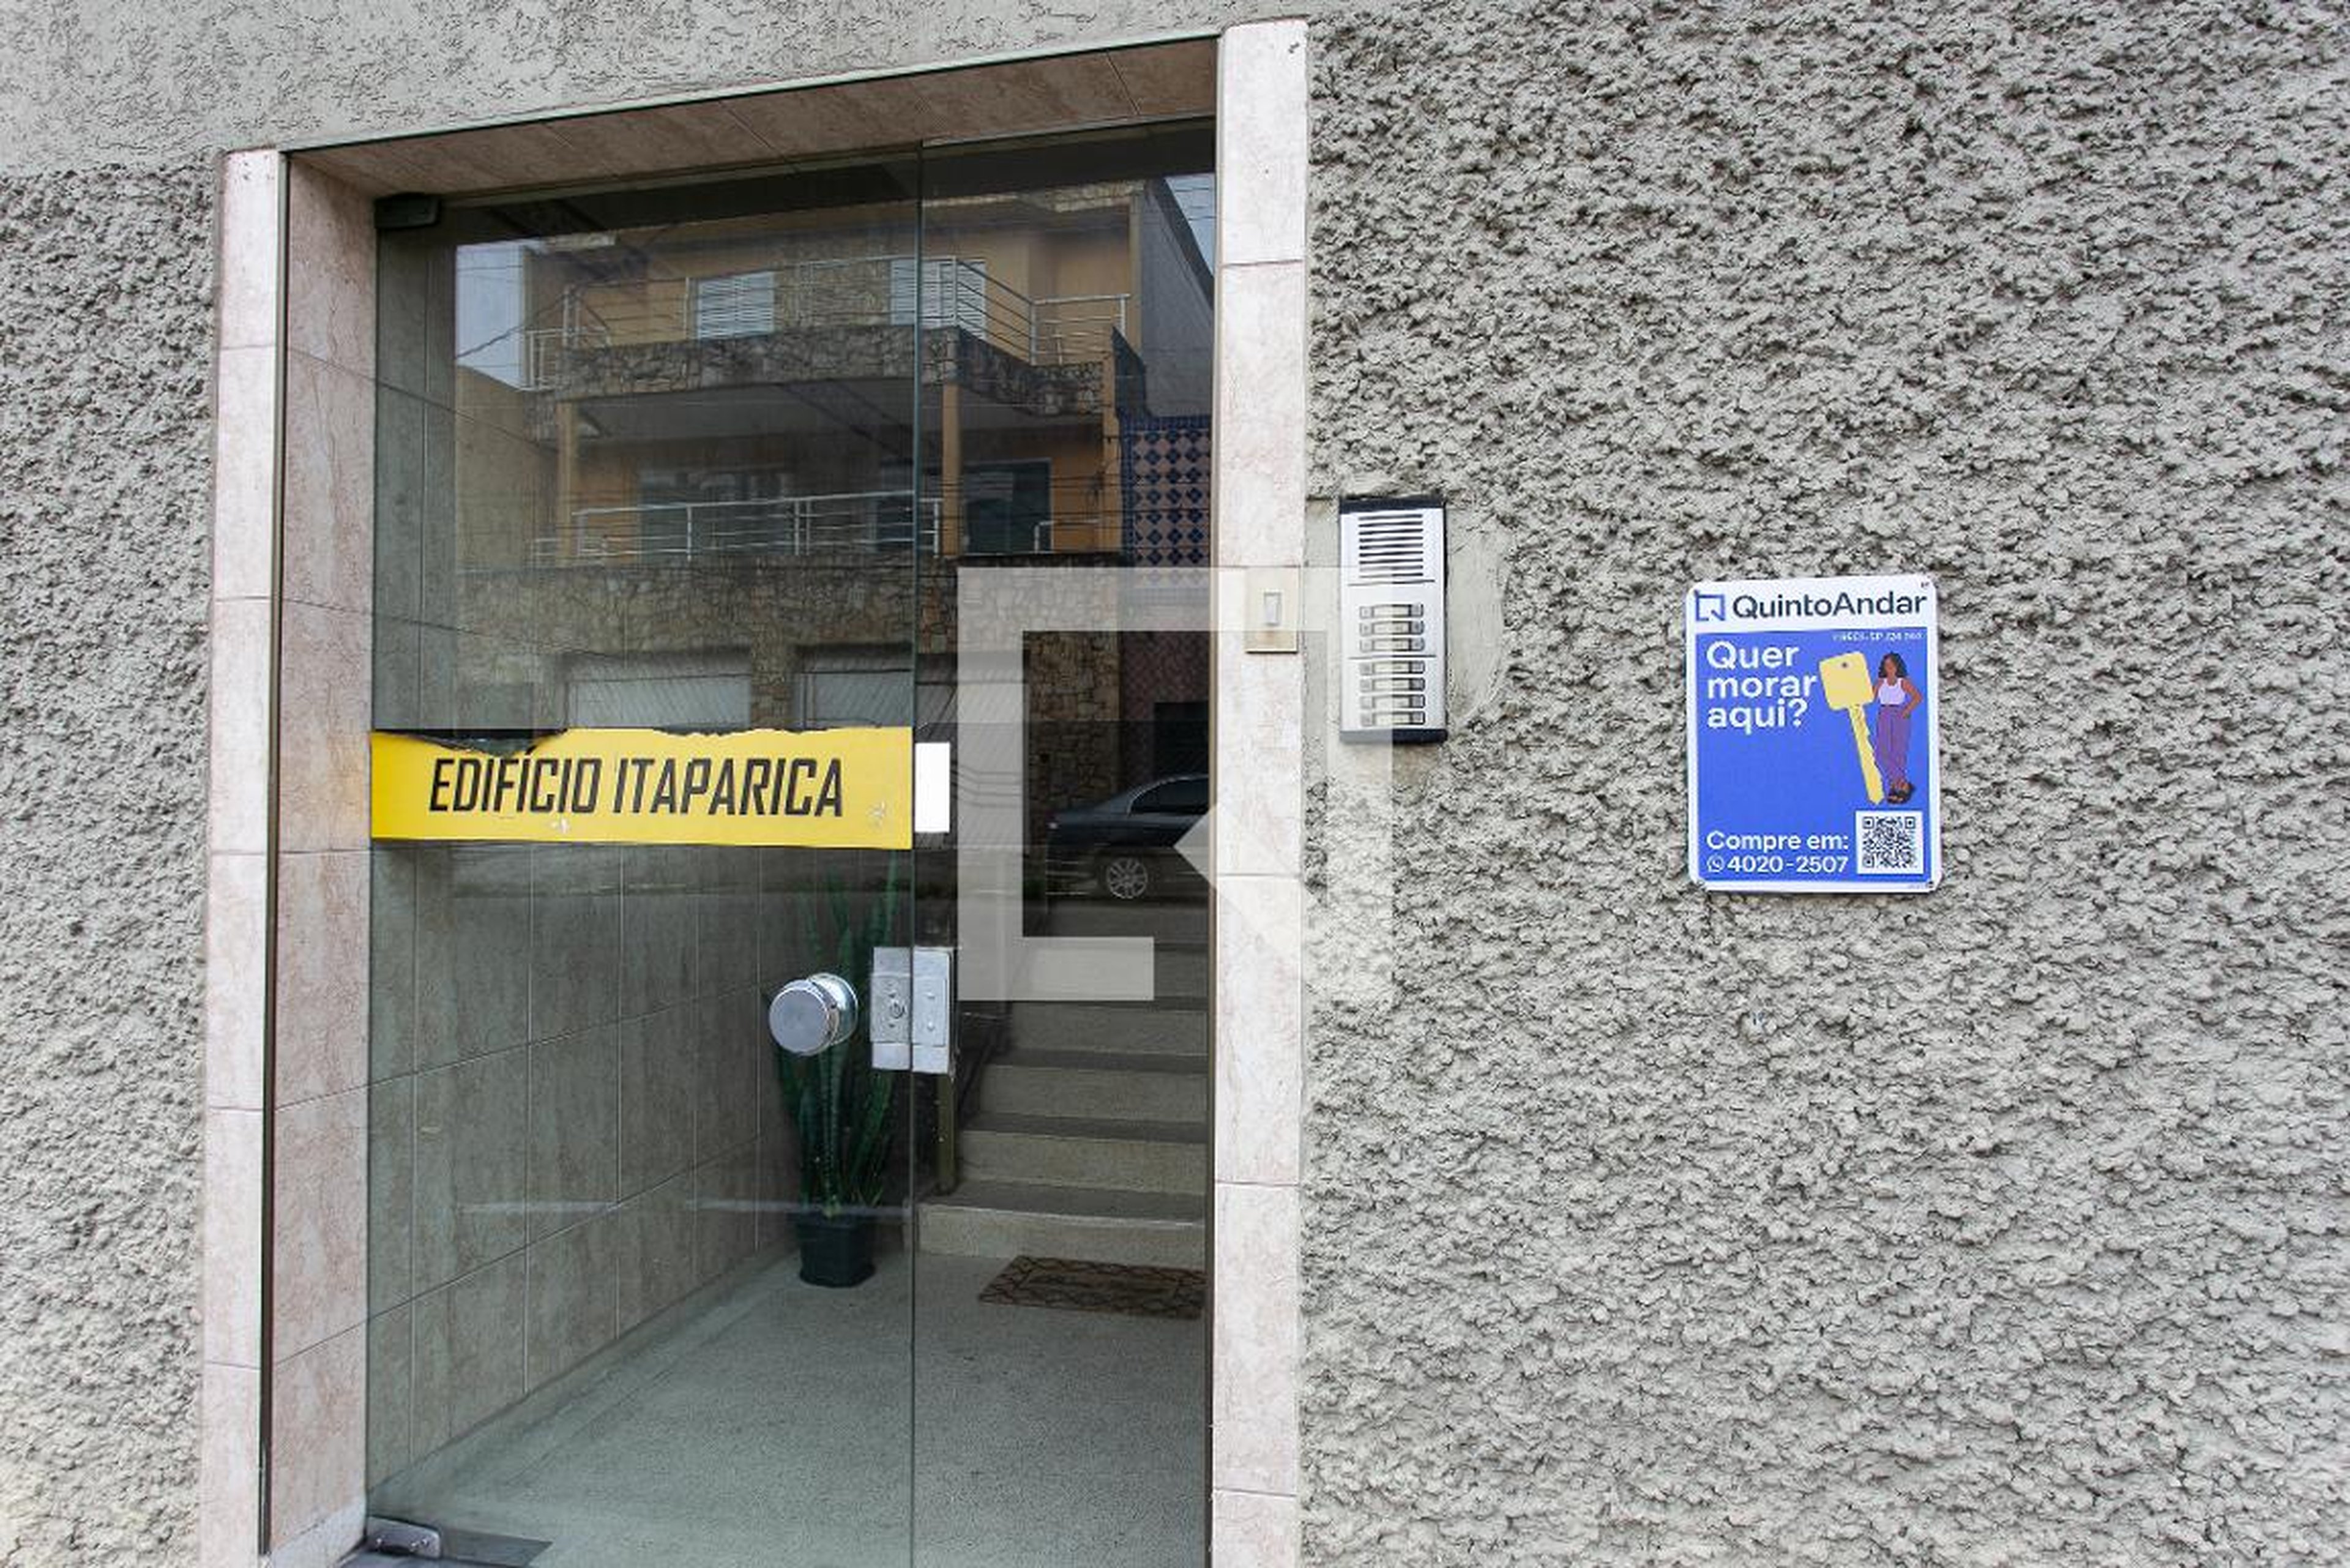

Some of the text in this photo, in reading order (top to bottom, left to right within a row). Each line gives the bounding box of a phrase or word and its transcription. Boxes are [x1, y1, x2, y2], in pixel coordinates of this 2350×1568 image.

[1733, 591, 1928, 619] QuintoAndar
[1706, 641, 1799, 670] Quer
[1707, 674, 1818, 699] morar
[1707, 699, 1808, 734] aqui?
[612, 758, 843, 817] ITAPARICA
[1706, 831, 1849, 853] Compre em:
[1727, 856, 1849, 873] 4020-2507
